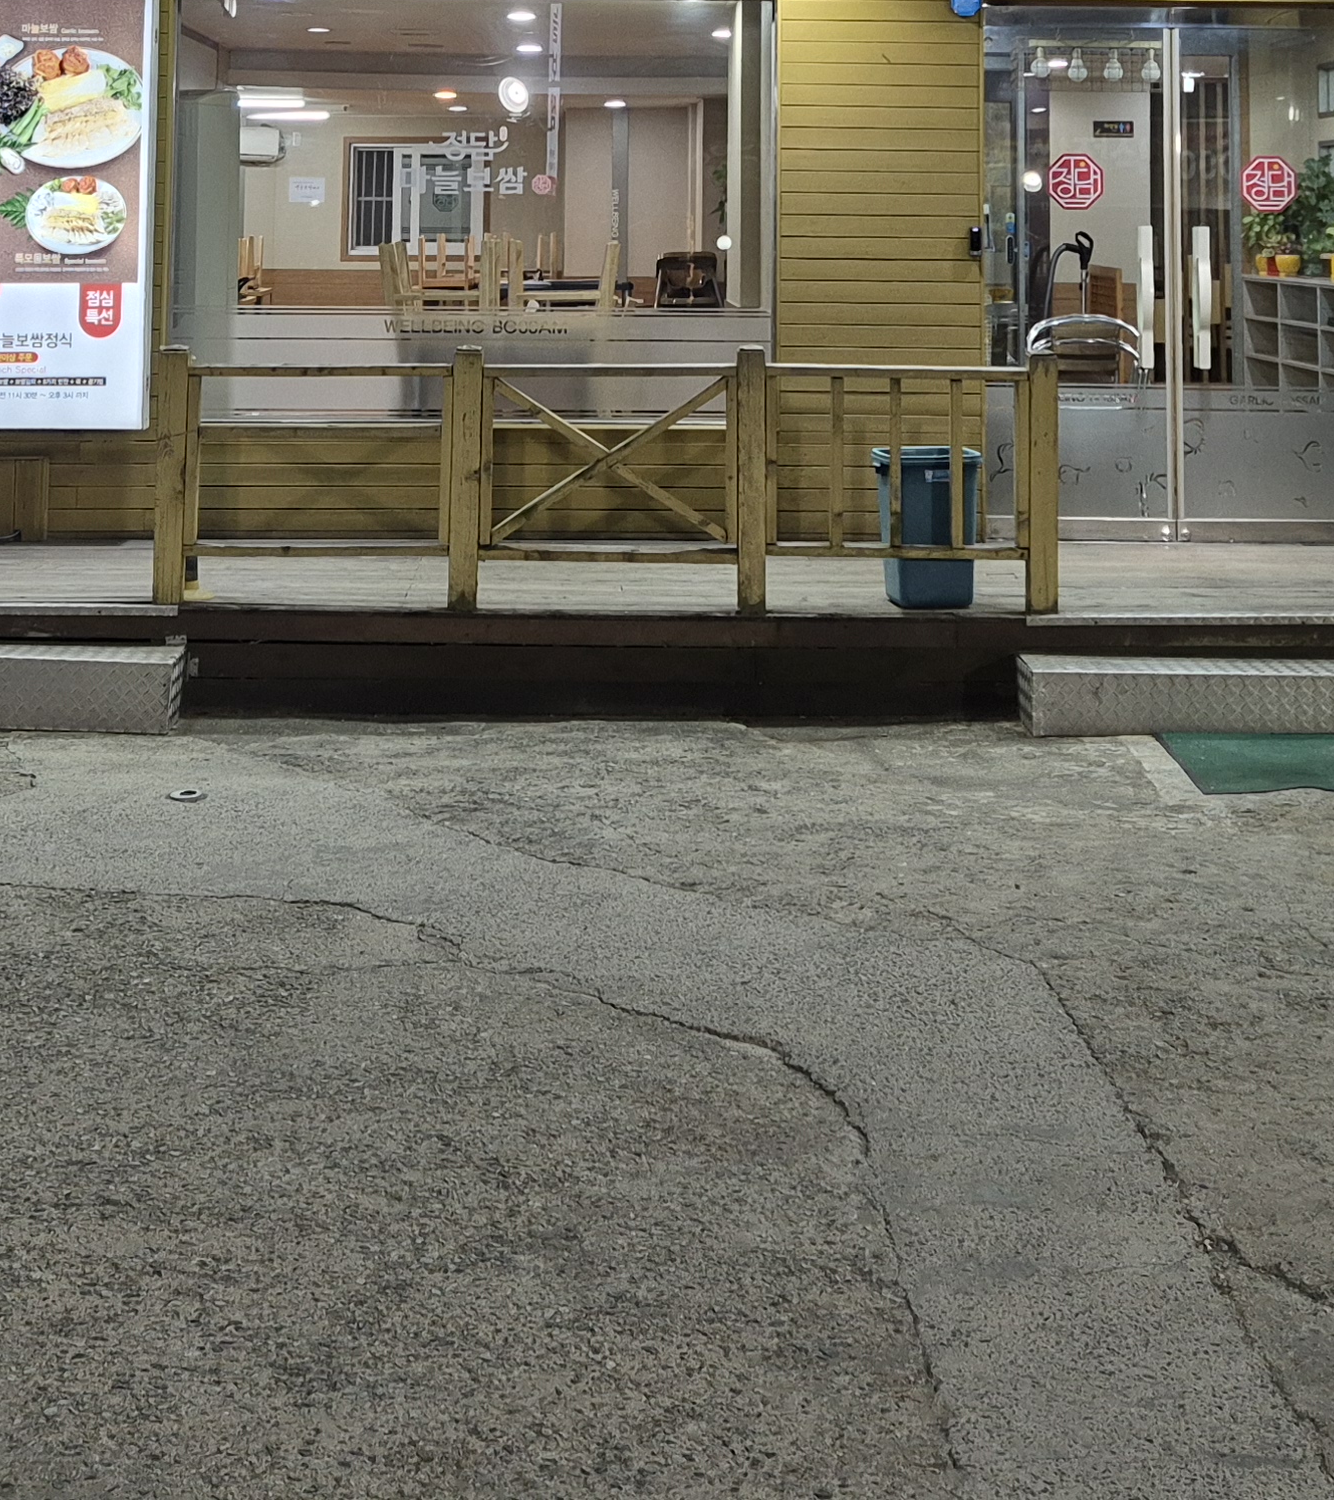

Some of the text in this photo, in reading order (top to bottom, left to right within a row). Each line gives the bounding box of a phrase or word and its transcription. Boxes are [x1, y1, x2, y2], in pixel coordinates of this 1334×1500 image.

[429, 129, 509, 162] 정담
[400, 165, 528, 195] 마늘보쌈
[1051, 157, 1099, 200] 정담
[1243, 160, 1296, 202] 정담
[85, 290, 114, 307] 점심
[85, 309, 114, 326] 특선
